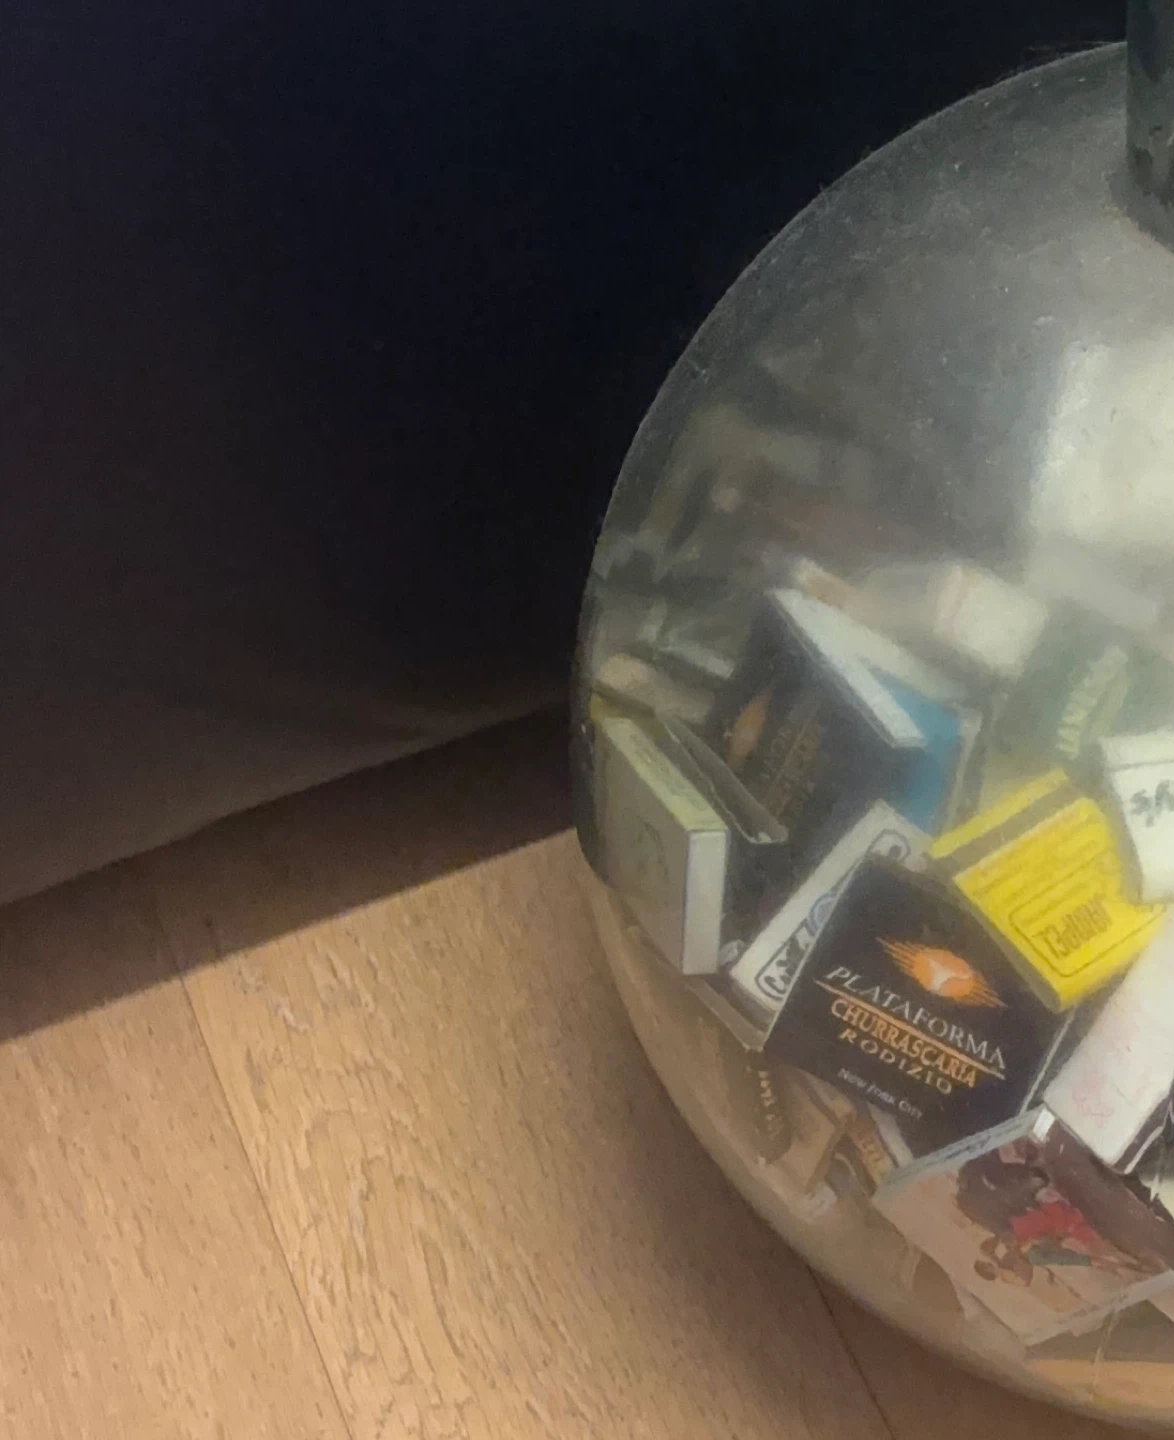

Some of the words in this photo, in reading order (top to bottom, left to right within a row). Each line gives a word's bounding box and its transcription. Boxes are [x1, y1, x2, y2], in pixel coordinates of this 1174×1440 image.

[826, 966, 1006, 1070] PLATAFORMA
[831, 998, 977, 1088] CHURRASCARIA
[838, 1028, 953, 1095] RODIZIO
